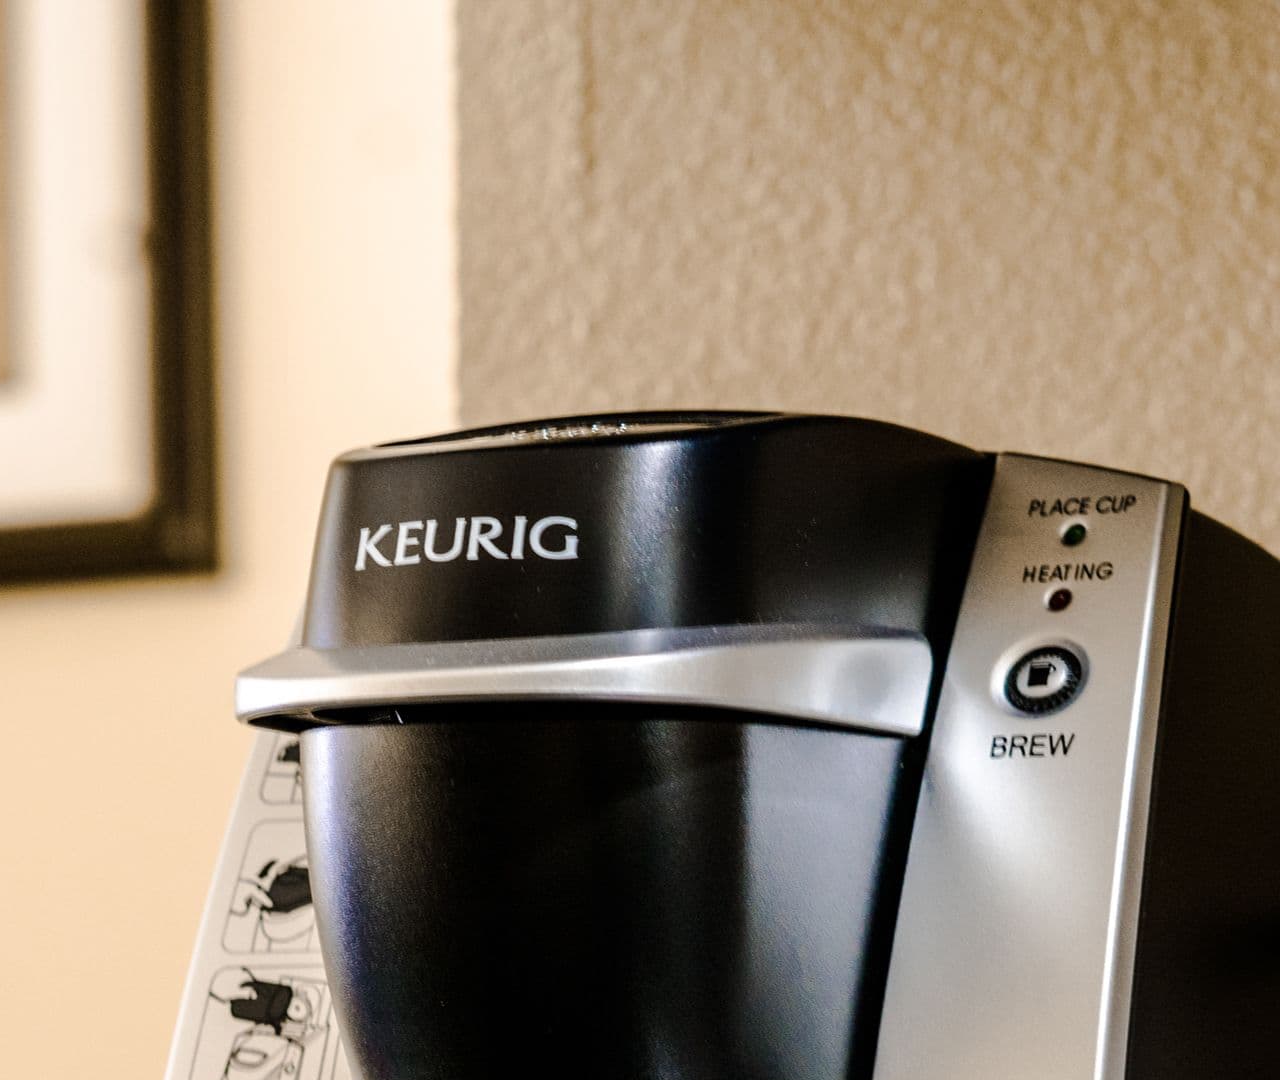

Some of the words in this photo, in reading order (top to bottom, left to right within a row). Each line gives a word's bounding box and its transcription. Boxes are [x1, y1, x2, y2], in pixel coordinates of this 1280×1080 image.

[1028, 497, 1090, 517] PLACE
[1095, 494, 1137, 514] CUP
[354, 515, 579, 571] KEURIG
[1023, 562, 1113, 583] HEATING
[990, 734, 1075, 758] BREW
